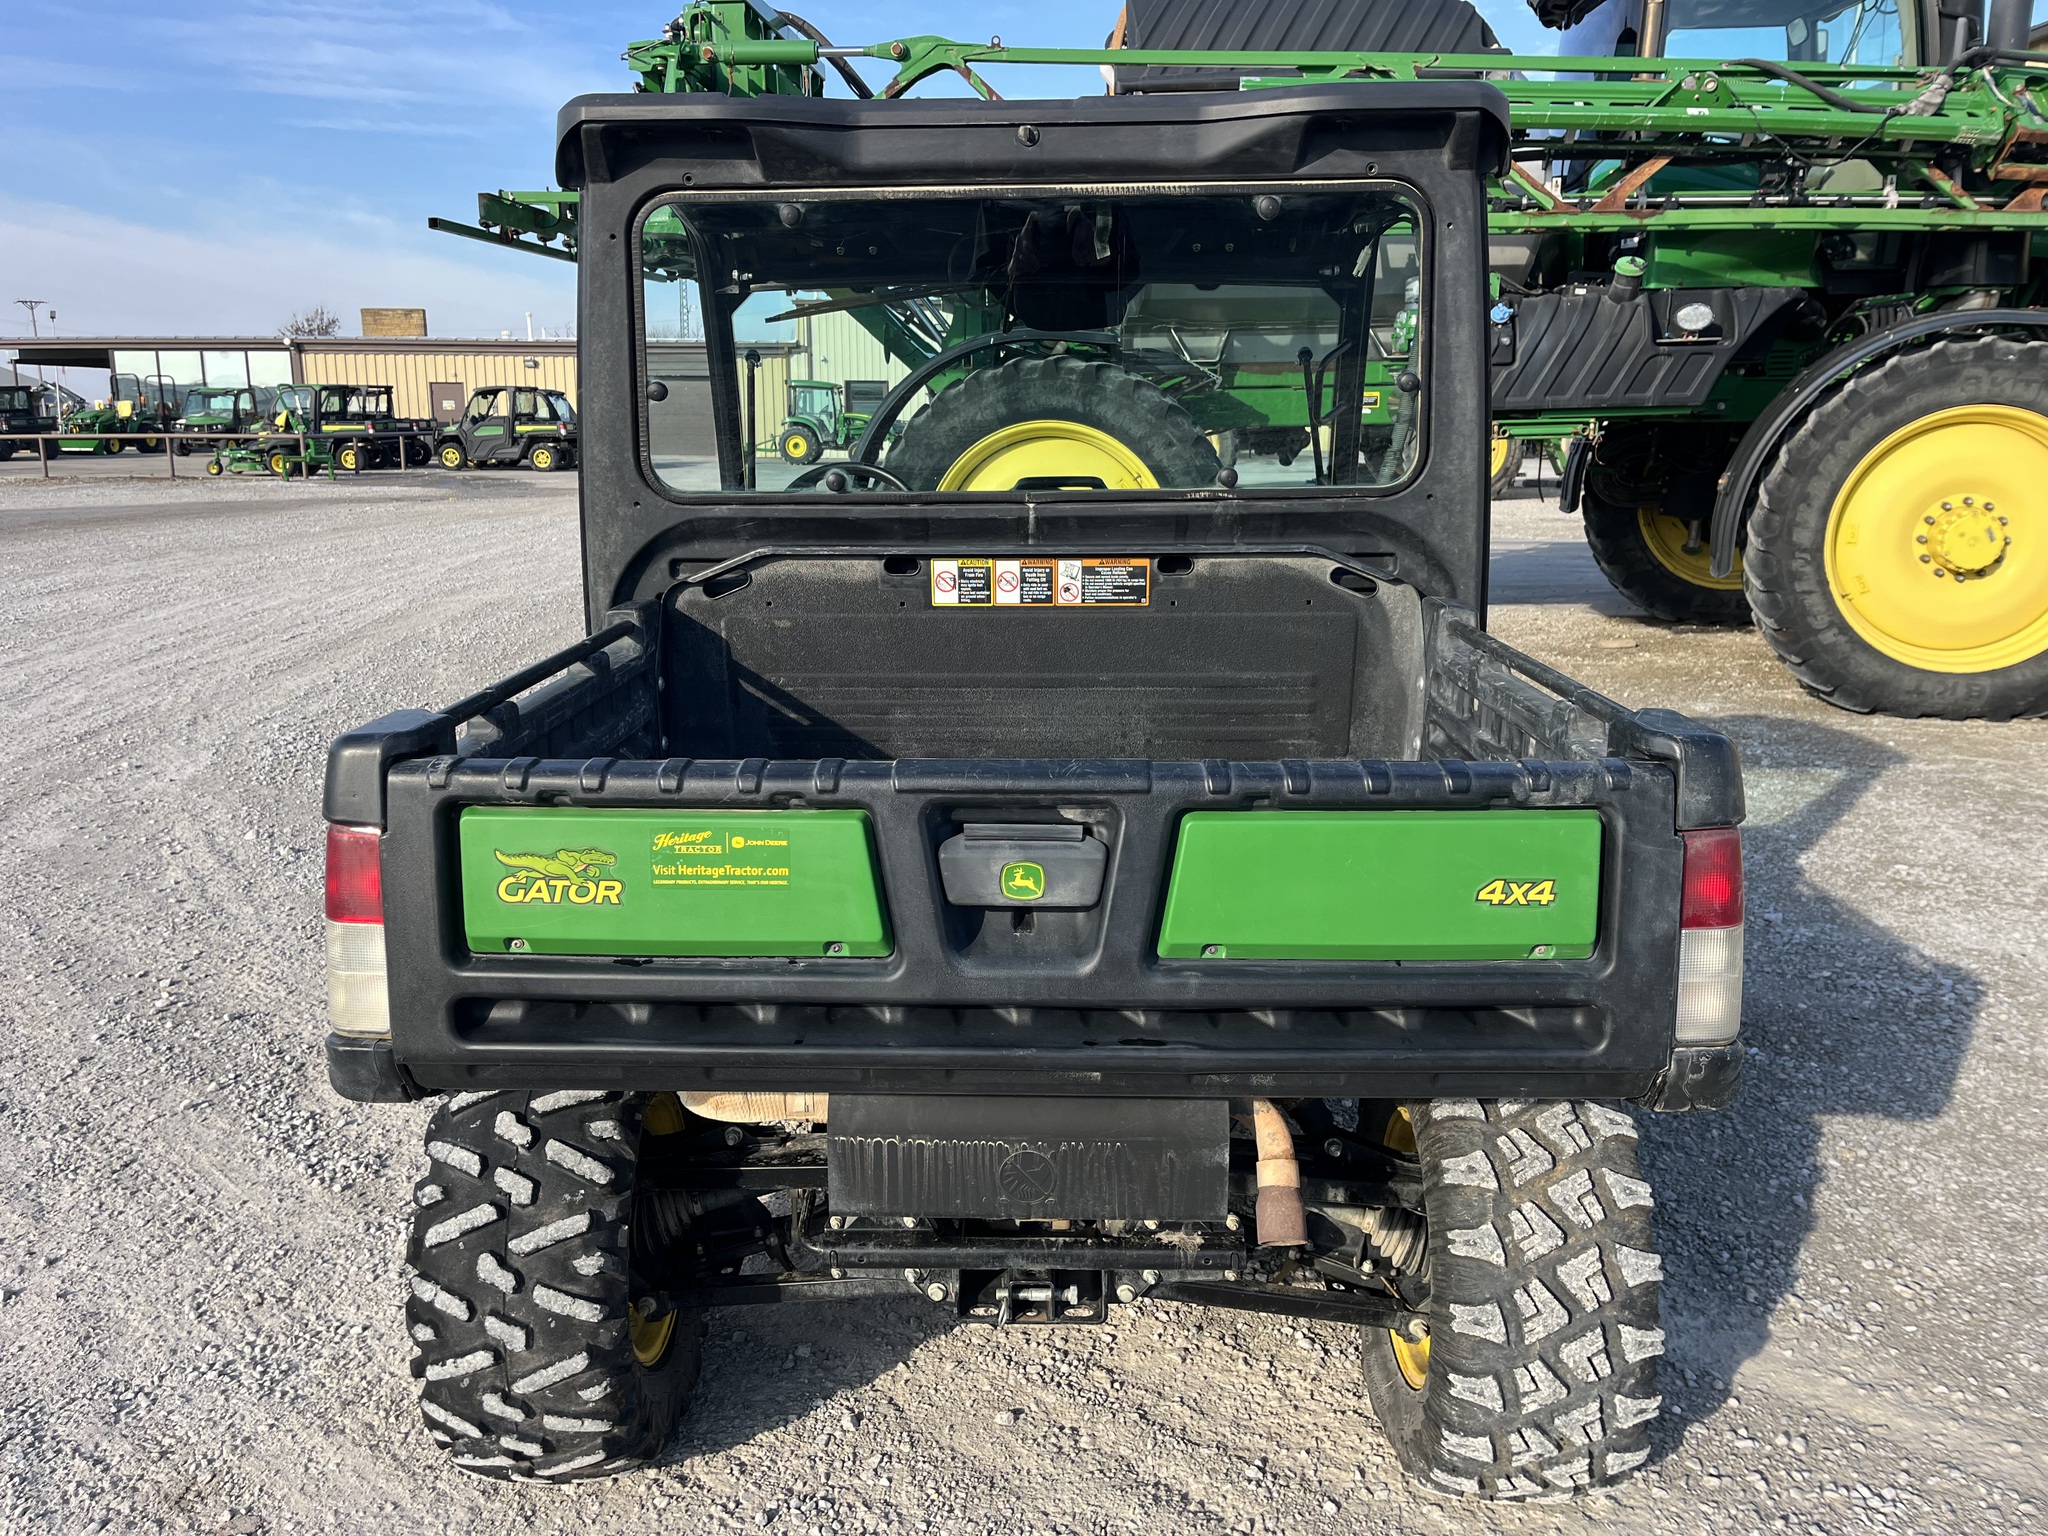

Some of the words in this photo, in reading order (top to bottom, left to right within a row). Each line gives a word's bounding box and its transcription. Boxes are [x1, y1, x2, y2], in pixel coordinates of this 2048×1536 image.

[652, 830, 713, 851] Heritage
[674, 846, 722, 854] TRACTOR
[652, 864, 676, 876] Visit
[678, 864, 789, 878] HeritageTractor.com
[496, 877, 624, 906] GATOR
[1475, 878, 1557, 906] 4x4
